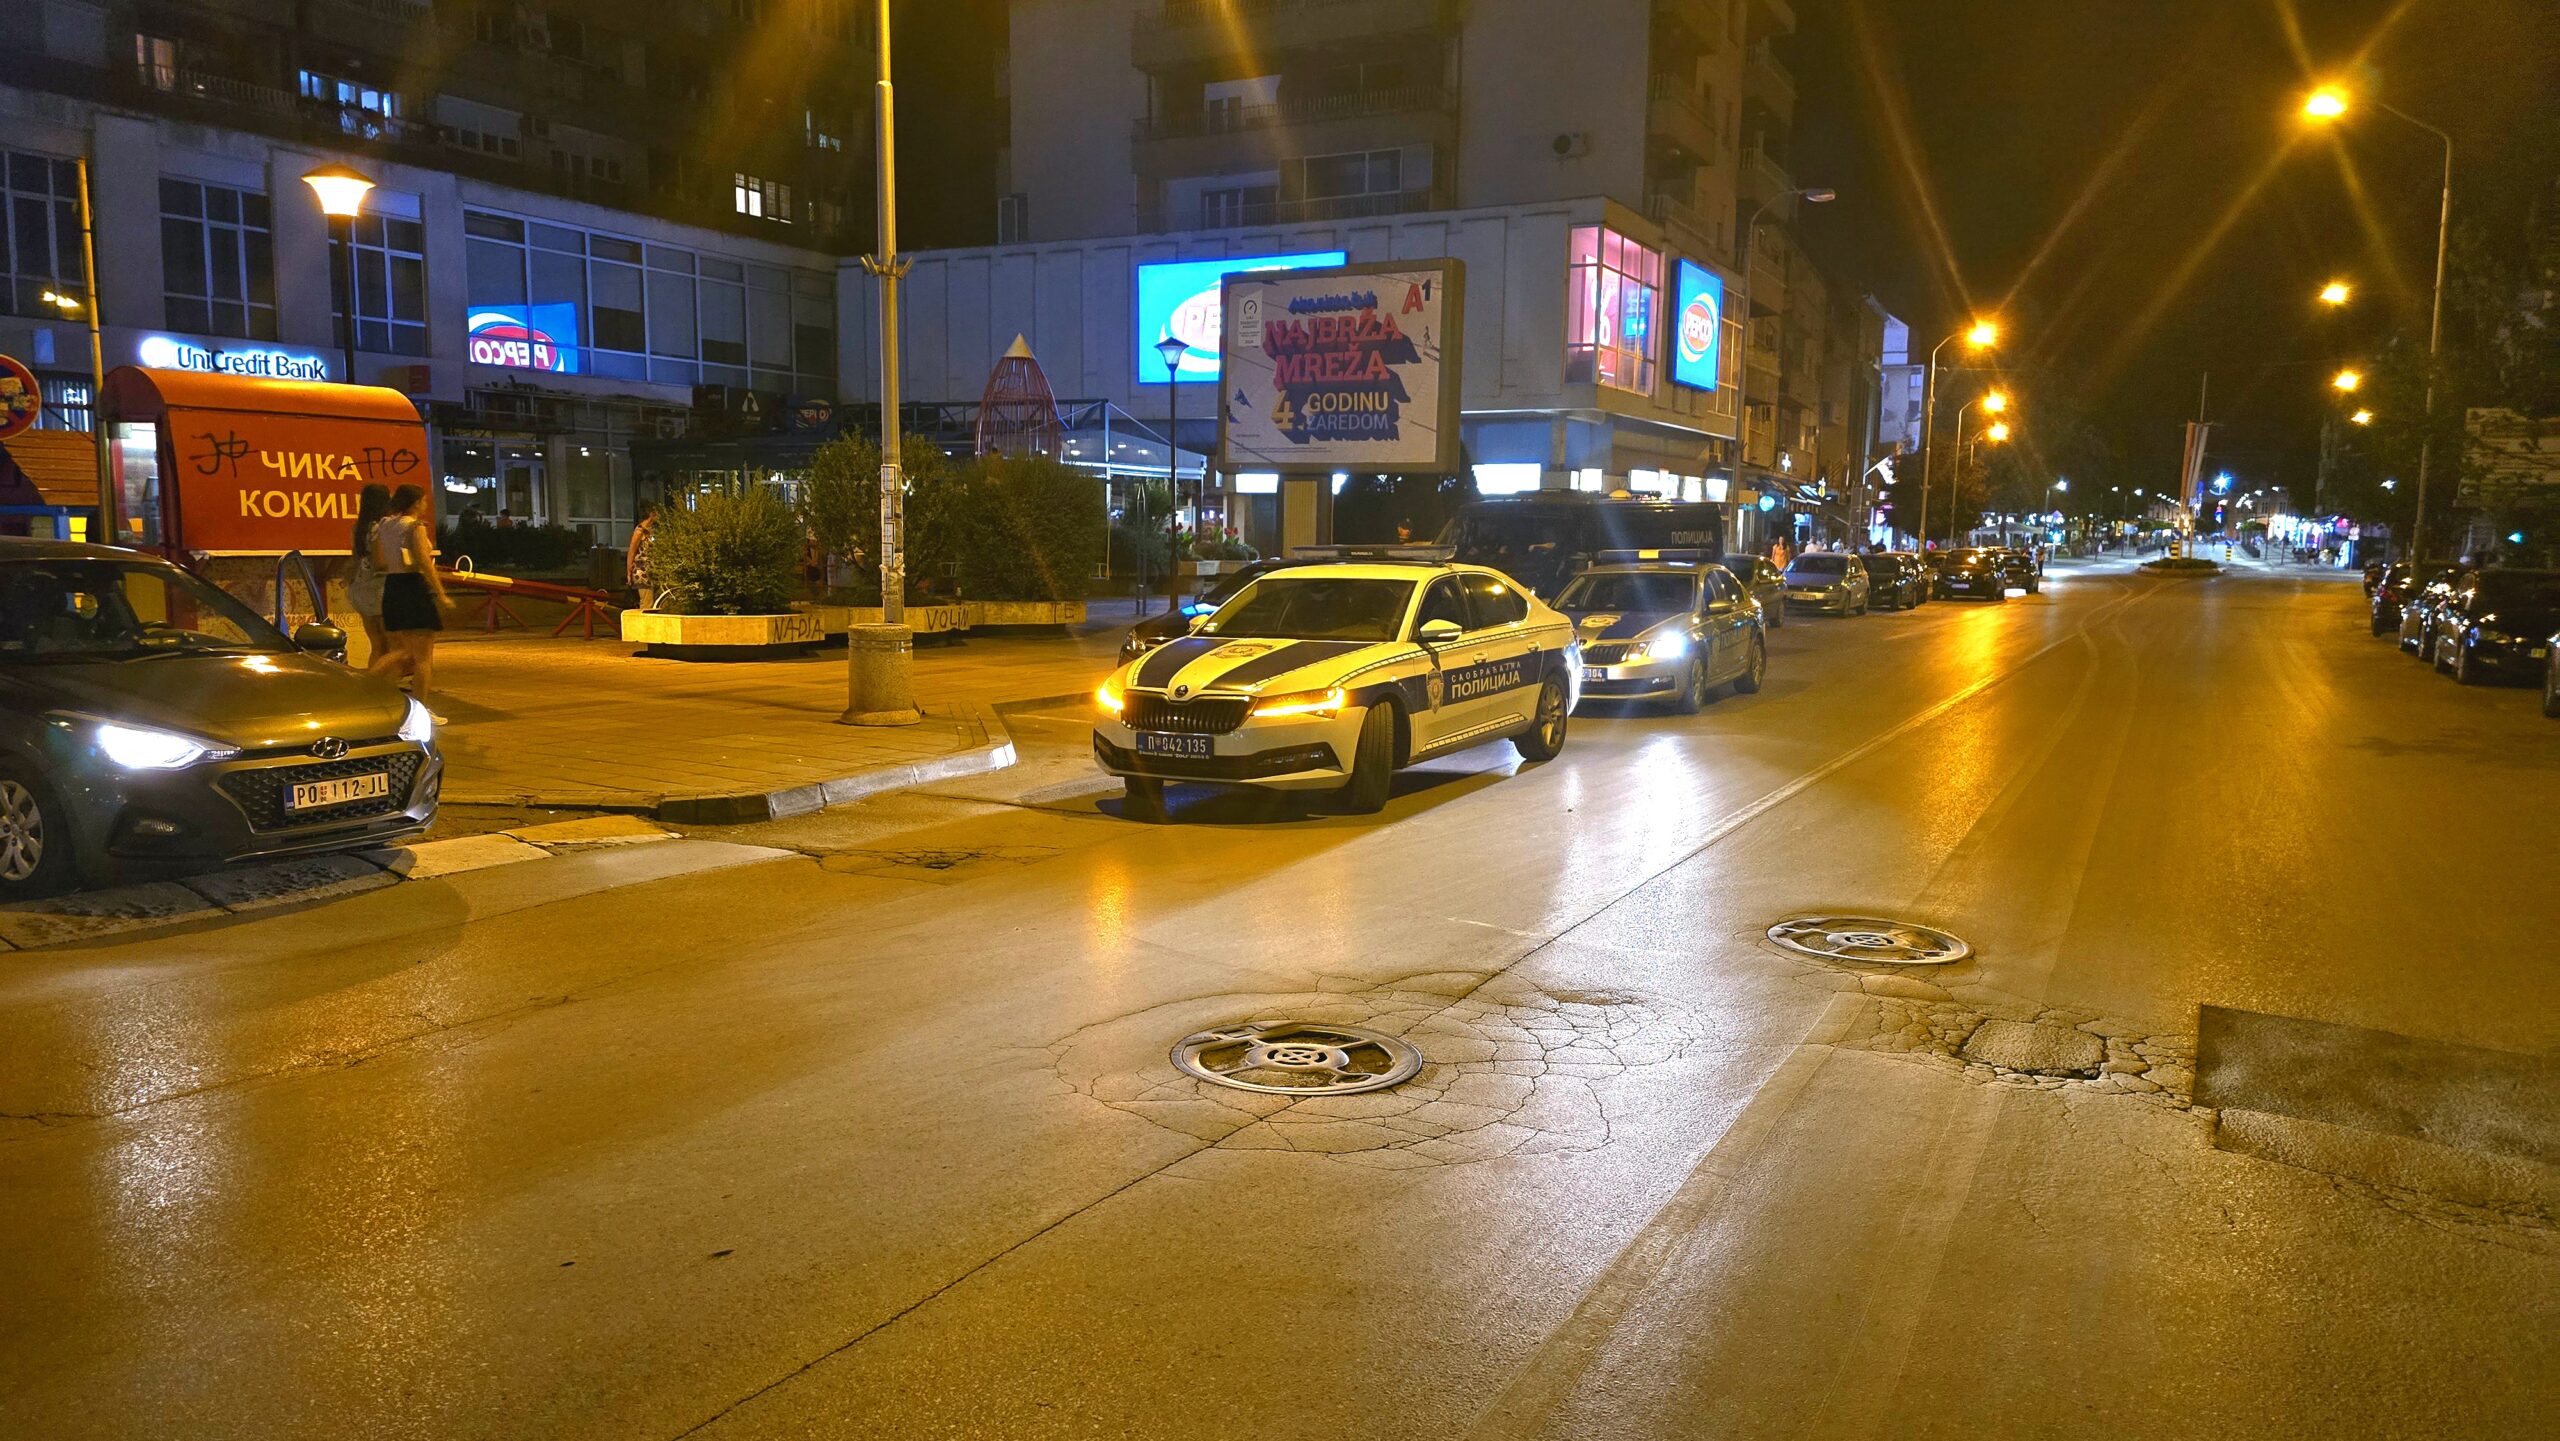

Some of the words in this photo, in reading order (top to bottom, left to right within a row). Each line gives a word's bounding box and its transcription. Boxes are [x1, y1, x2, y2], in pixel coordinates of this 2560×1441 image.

[1401, 278, 1431, 315] A1
[1264, 308, 1404, 348] NAJBRŽA
[177, 346, 271, 376] UniCredit
[276, 355, 326, 380] Bank
[1273, 342, 1390, 387] MREŽA
[1307, 391, 1389, 413] GODINU
[1306, 413, 1389, 431] ZAREDOM
[260, 450, 363, 481] ЧИКА
[239, 489, 362, 520] КОКИЦ
[1671, 529, 1714, 546] ПОЛИЦИЈА
[1451, 661, 1521, 683] САОБРАЋАЈНА
[1451, 669, 1521, 699] ПОЛИЦИЈА
